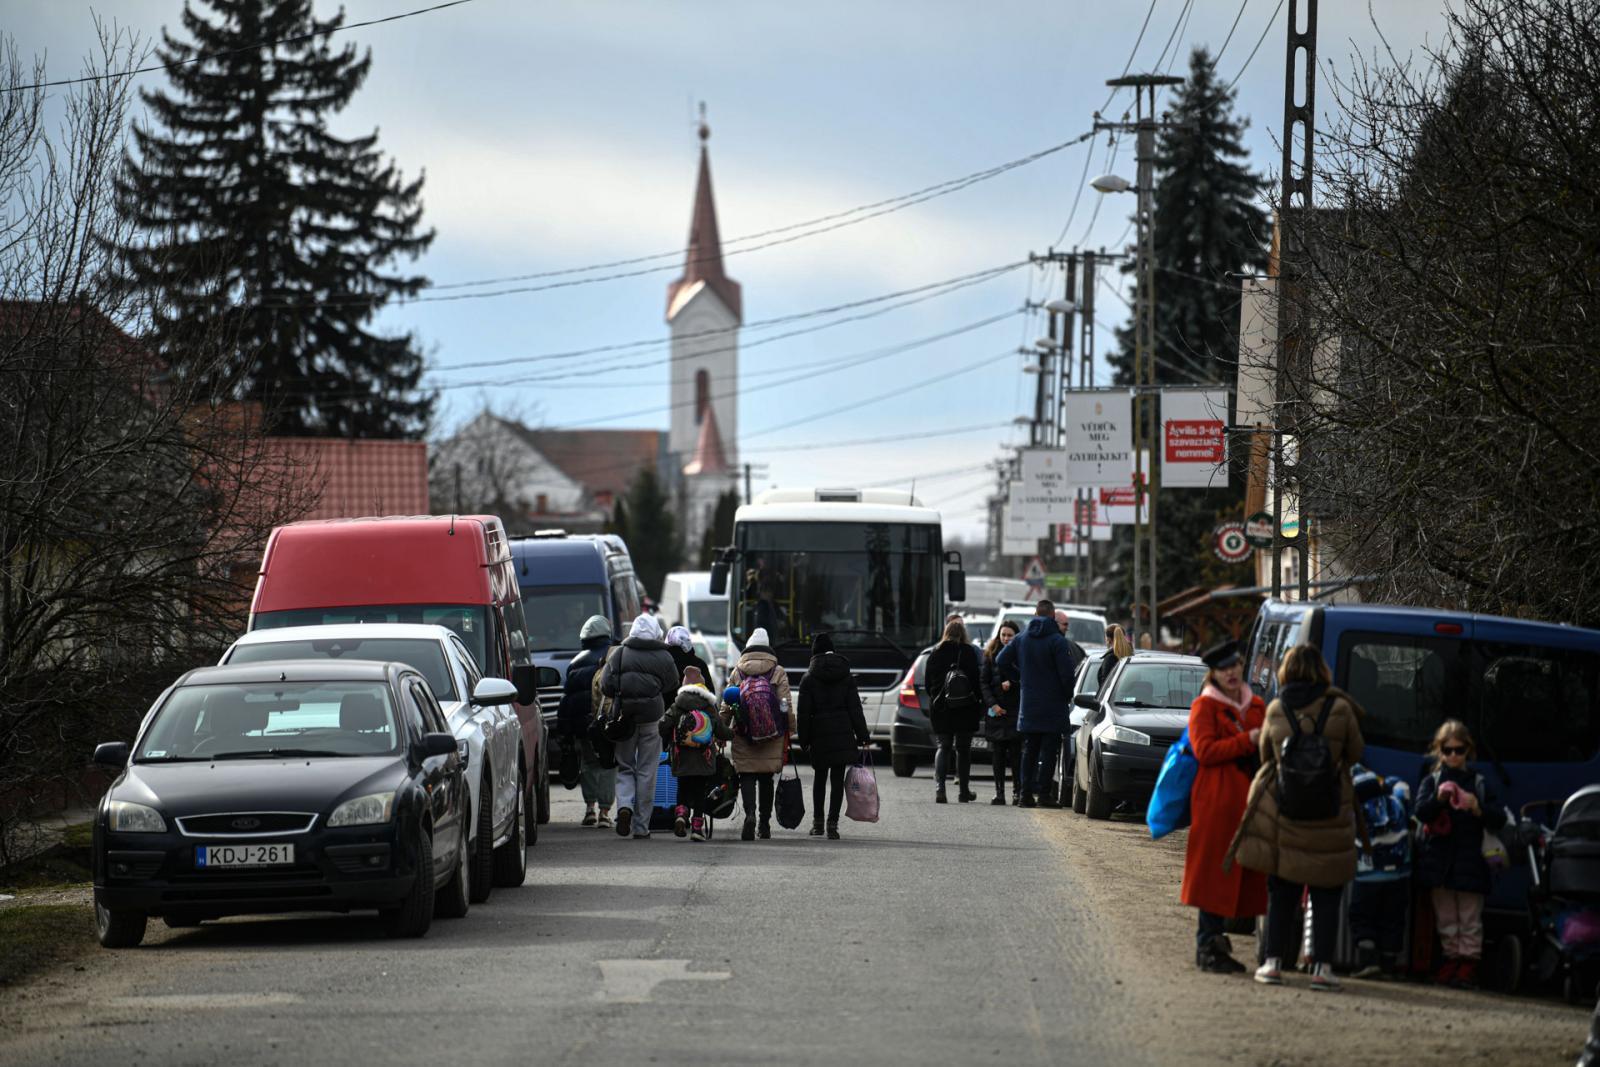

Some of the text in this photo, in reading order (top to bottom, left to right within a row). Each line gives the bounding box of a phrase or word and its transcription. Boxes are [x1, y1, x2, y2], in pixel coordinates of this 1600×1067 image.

[1089, 432, 1110, 442] MEG
[1068, 452, 1129, 462] GYEREKEKET
[209, 846, 288, 864] KDJ-261
